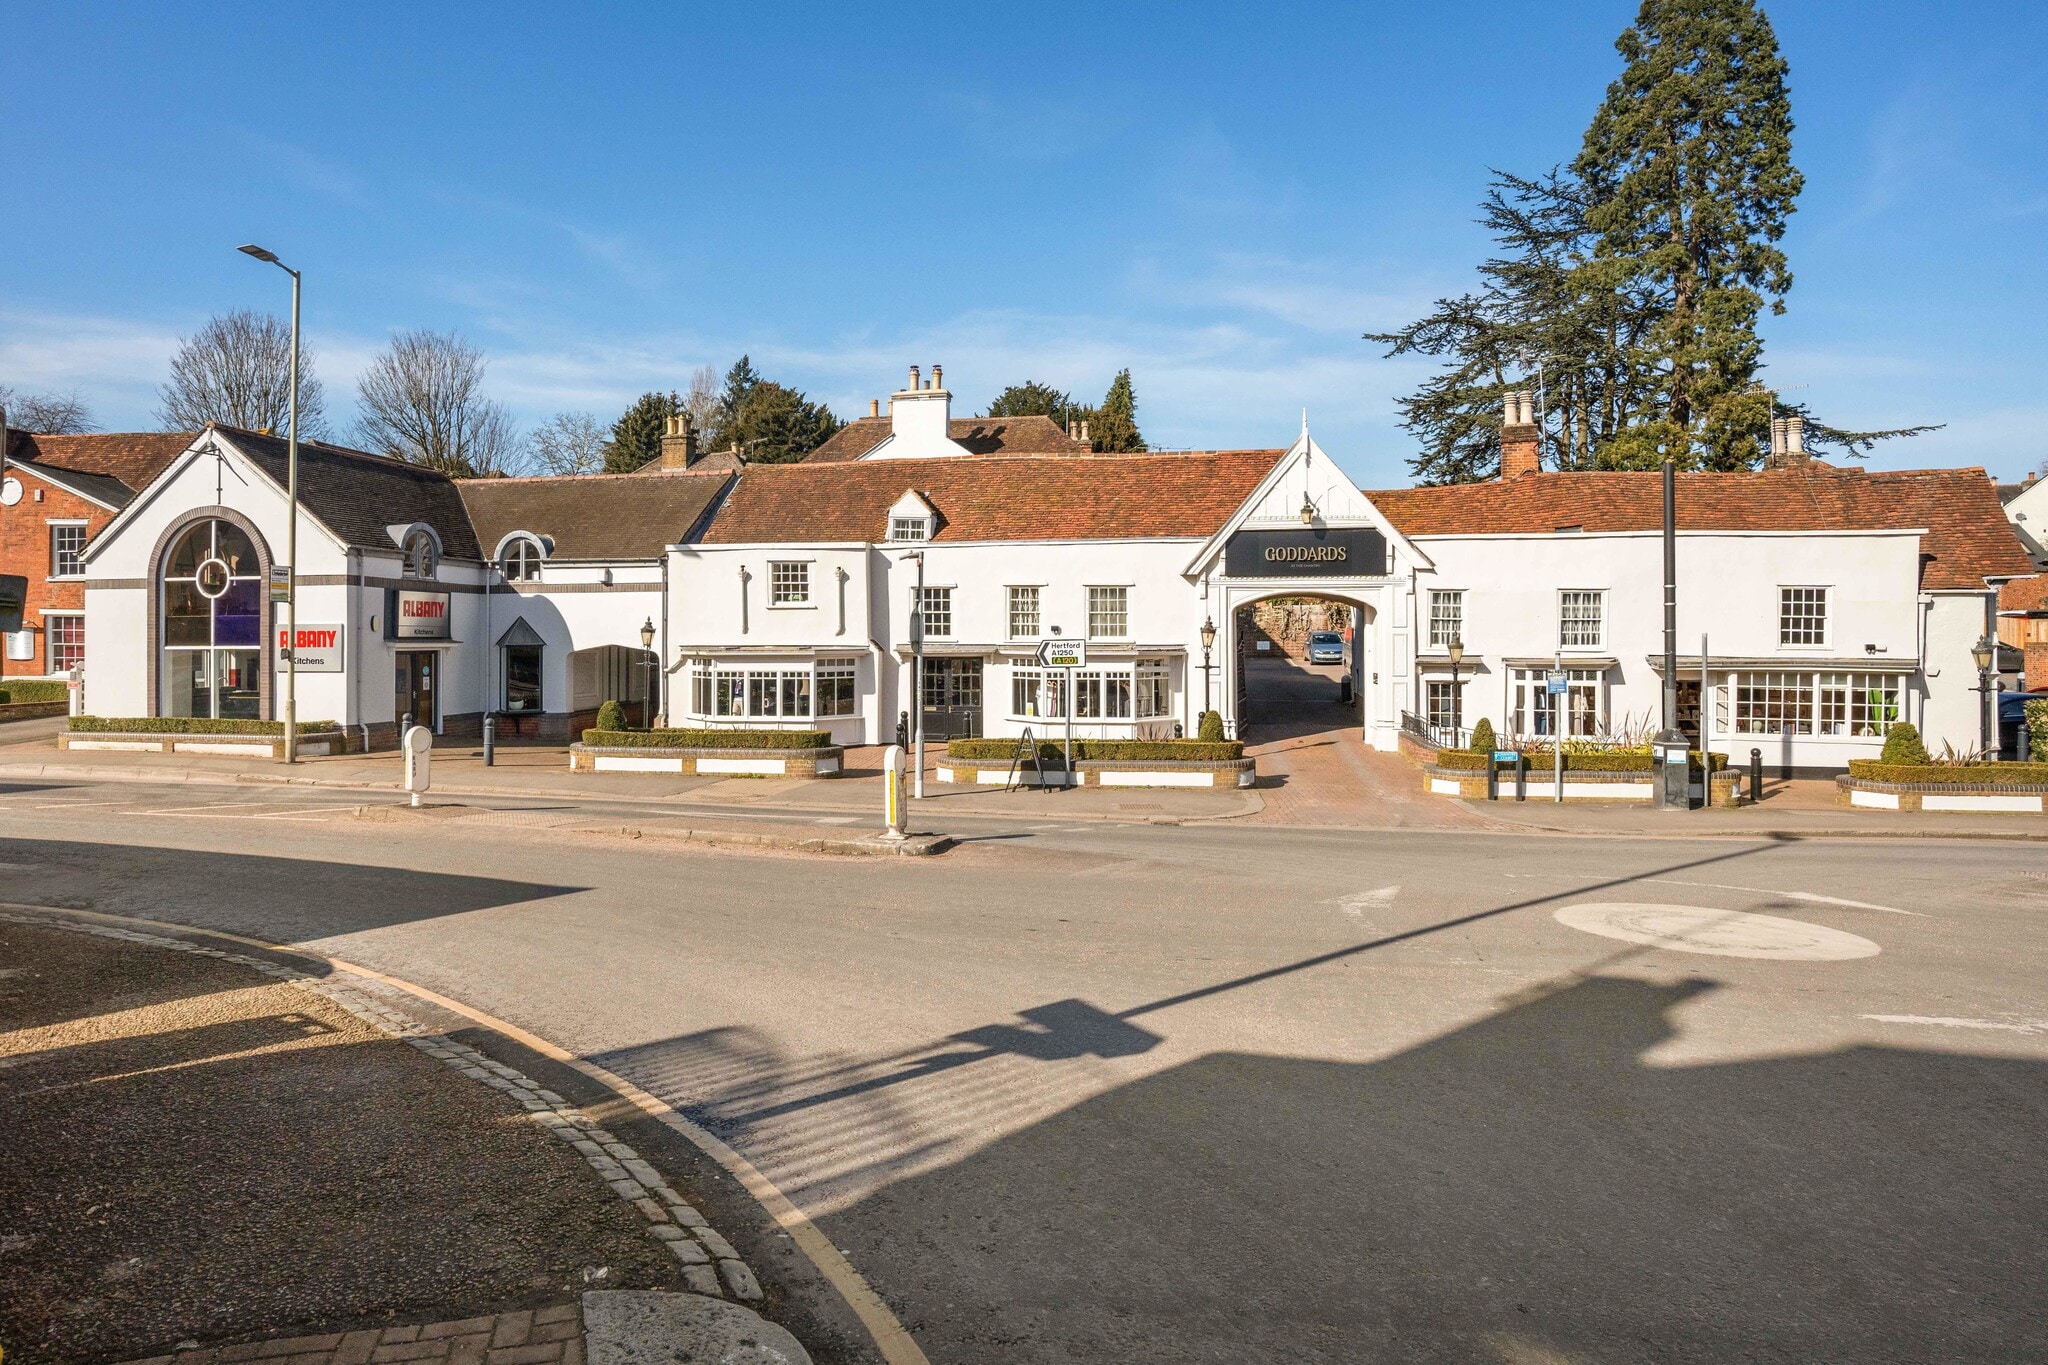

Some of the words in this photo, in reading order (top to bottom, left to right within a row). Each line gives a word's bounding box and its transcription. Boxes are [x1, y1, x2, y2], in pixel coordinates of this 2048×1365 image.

[1264, 546, 1347, 561] GODDARDS
[403, 600, 445, 618] ALBANY
[279, 630, 337, 648] ABANY
